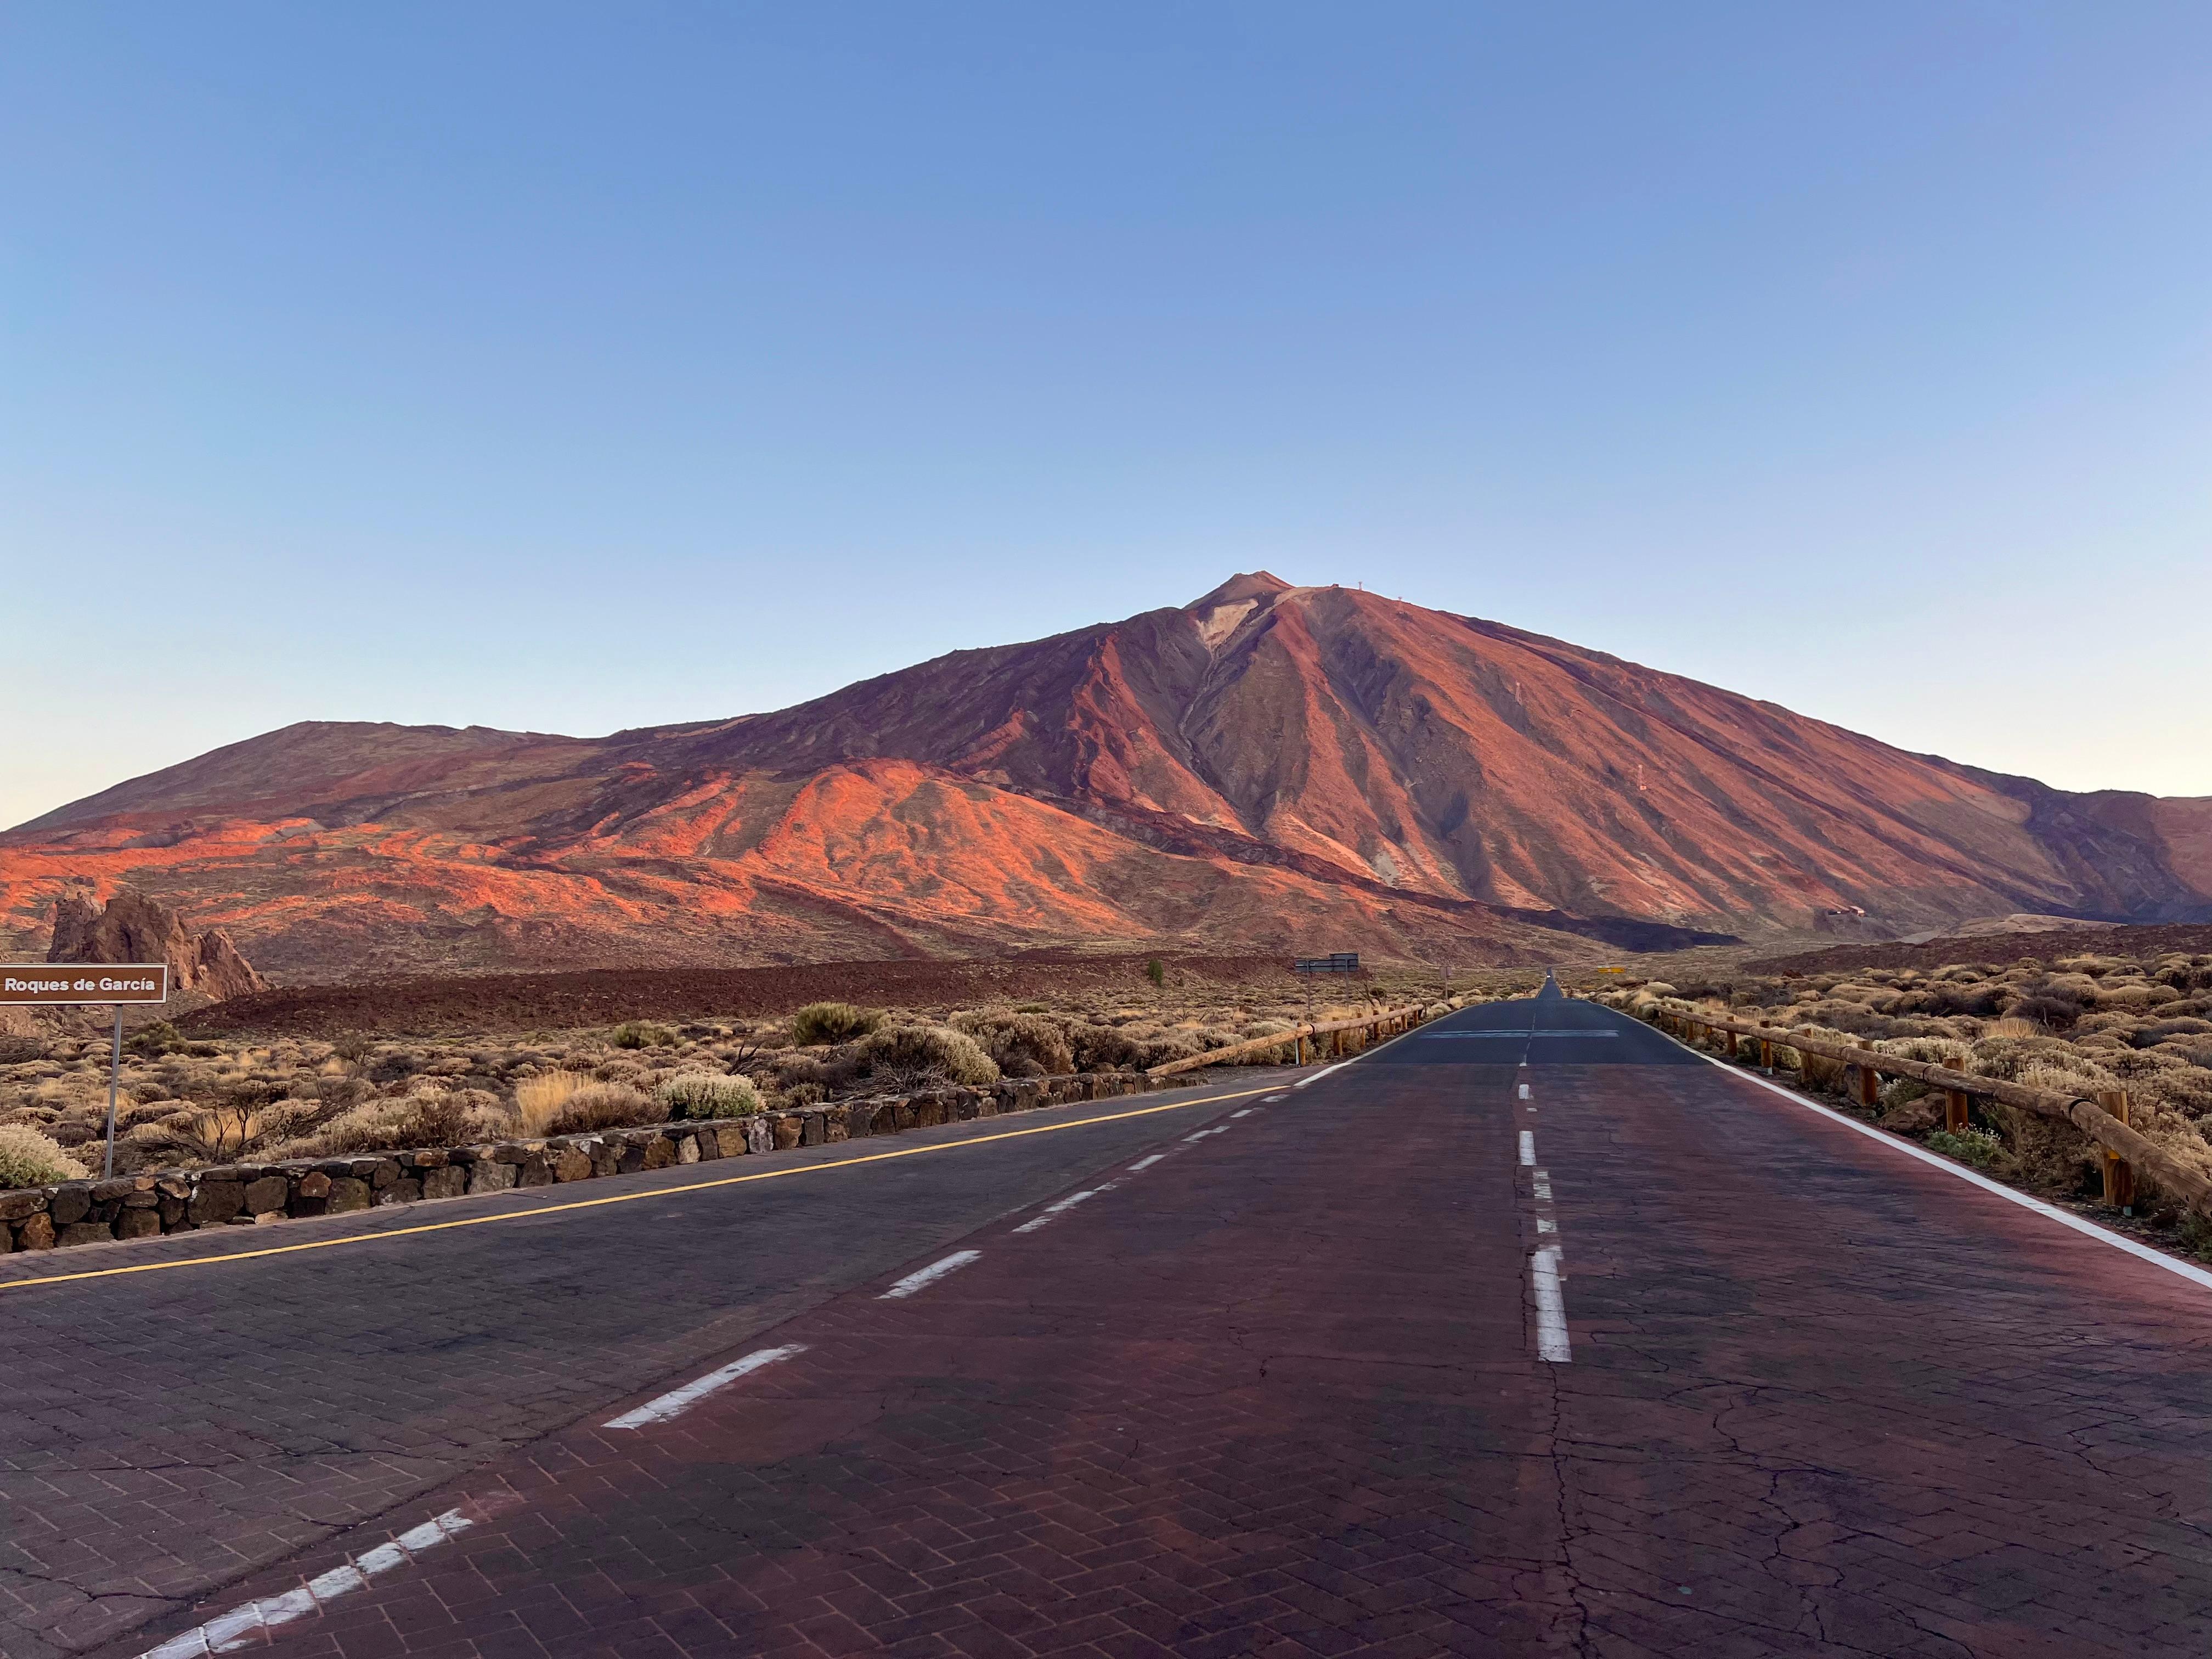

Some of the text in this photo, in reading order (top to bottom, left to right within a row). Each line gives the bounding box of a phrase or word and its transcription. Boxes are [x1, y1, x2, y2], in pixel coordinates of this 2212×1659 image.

[4, 977, 155, 994] Roques de García
